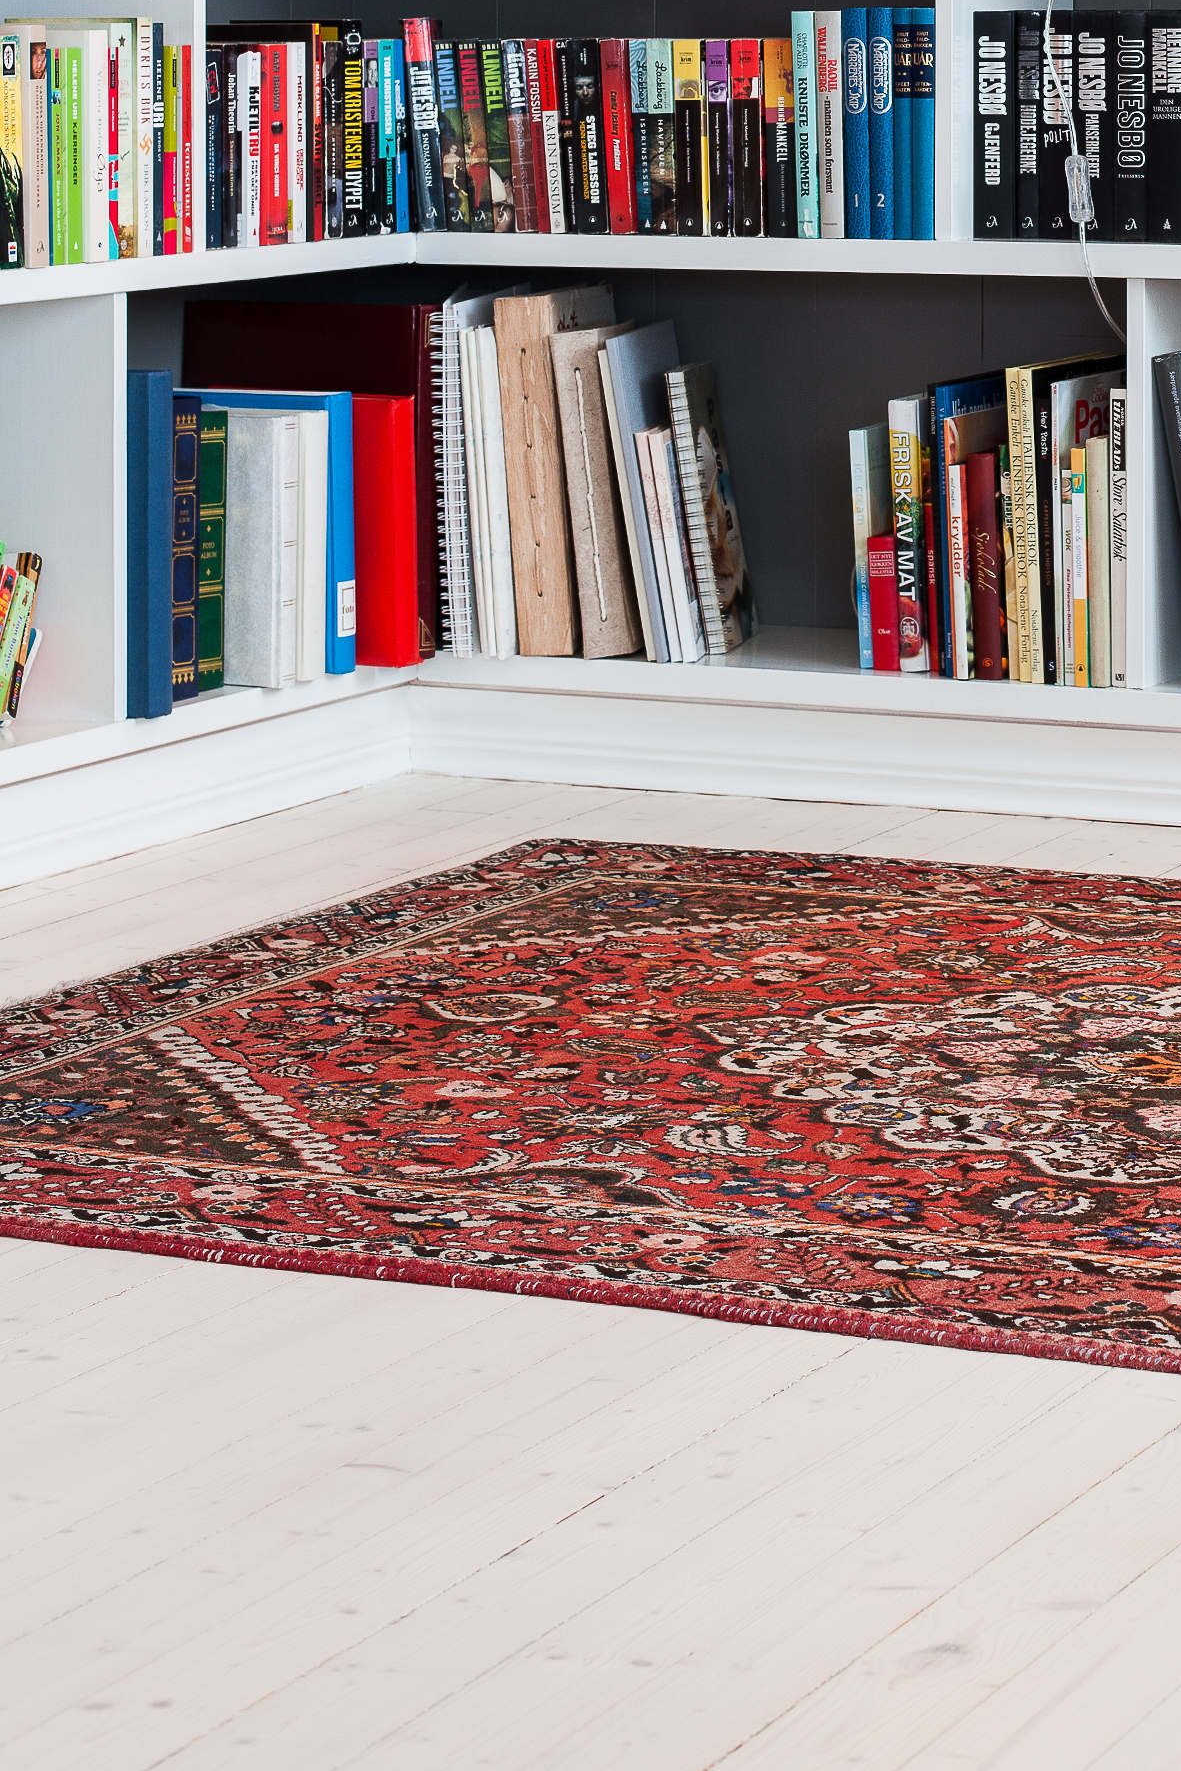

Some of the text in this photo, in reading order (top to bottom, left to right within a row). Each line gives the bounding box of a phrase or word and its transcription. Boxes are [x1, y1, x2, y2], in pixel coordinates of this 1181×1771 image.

[436, 49, 459, 113] LINDELL
[459, 49, 481, 113] LINDELL
[482, 49, 504, 114] LINDELL
[507, 52, 525, 109] Lindell
[817, 26, 828, 93] WALLENBERG
[827, 58, 838, 93] RAOUL
[847, 42, 860, 88] NARRENES
[872, 42, 885, 88] NARRENES
[1078, 31, 1107, 112] JO NESBØ
[1117, 34, 1146, 69] JO
[1151, 27, 1168, 94] MANKELL
[141, 97, 153, 126] BUK
[153, 101, 165, 128] URI
[227, 72, 237, 135] Johan Theorin
[383, 55, 393, 136] TOM KRISTENSEN
[526, 47, 542, 124] KARIN FOSSUM
[777, 96, 786, 122] HENNING
[978, 35, 1007, 187] JO NESBØ GJENFERD
[248, 85, 261, 158] KJETIL TRY
[344, 59, 363, 211] TOM KRISTENSEN DYPET
[657, 118, 666, 177] HAVFRUEN
[776, 121, 788, 163] MANKELL
[797, 77, 810, 198] KNUSTE DRØMMER
[1019, 104, 1037, 175] HODEJEGERNE
[1116, 72, 1146, 168] NESBØ
[544, 114, 561, 216] KARIN FOSSUM
[585, 115, 600, 205] STIEG LARSSON
[639, 117, 650, 195] ISPRINSESSEN
[824, 137, 835, 194] som forsvant
[854, 193, 859, 208] 1
[876, 193, 886, 208] 2
[892, 431, 916, 602] FRISK AV MAT
[1010, 417, 1027, 579] Enkelt KINESISK KOKEBOK
[1021, 407, 1038, 568] enkelt ITALIENSK KOKEBOK
[926, 548, 937, 585] spansk
[950, 515, 963, 578] krydder
[1111, 508, 1128, 563] Salatbok
